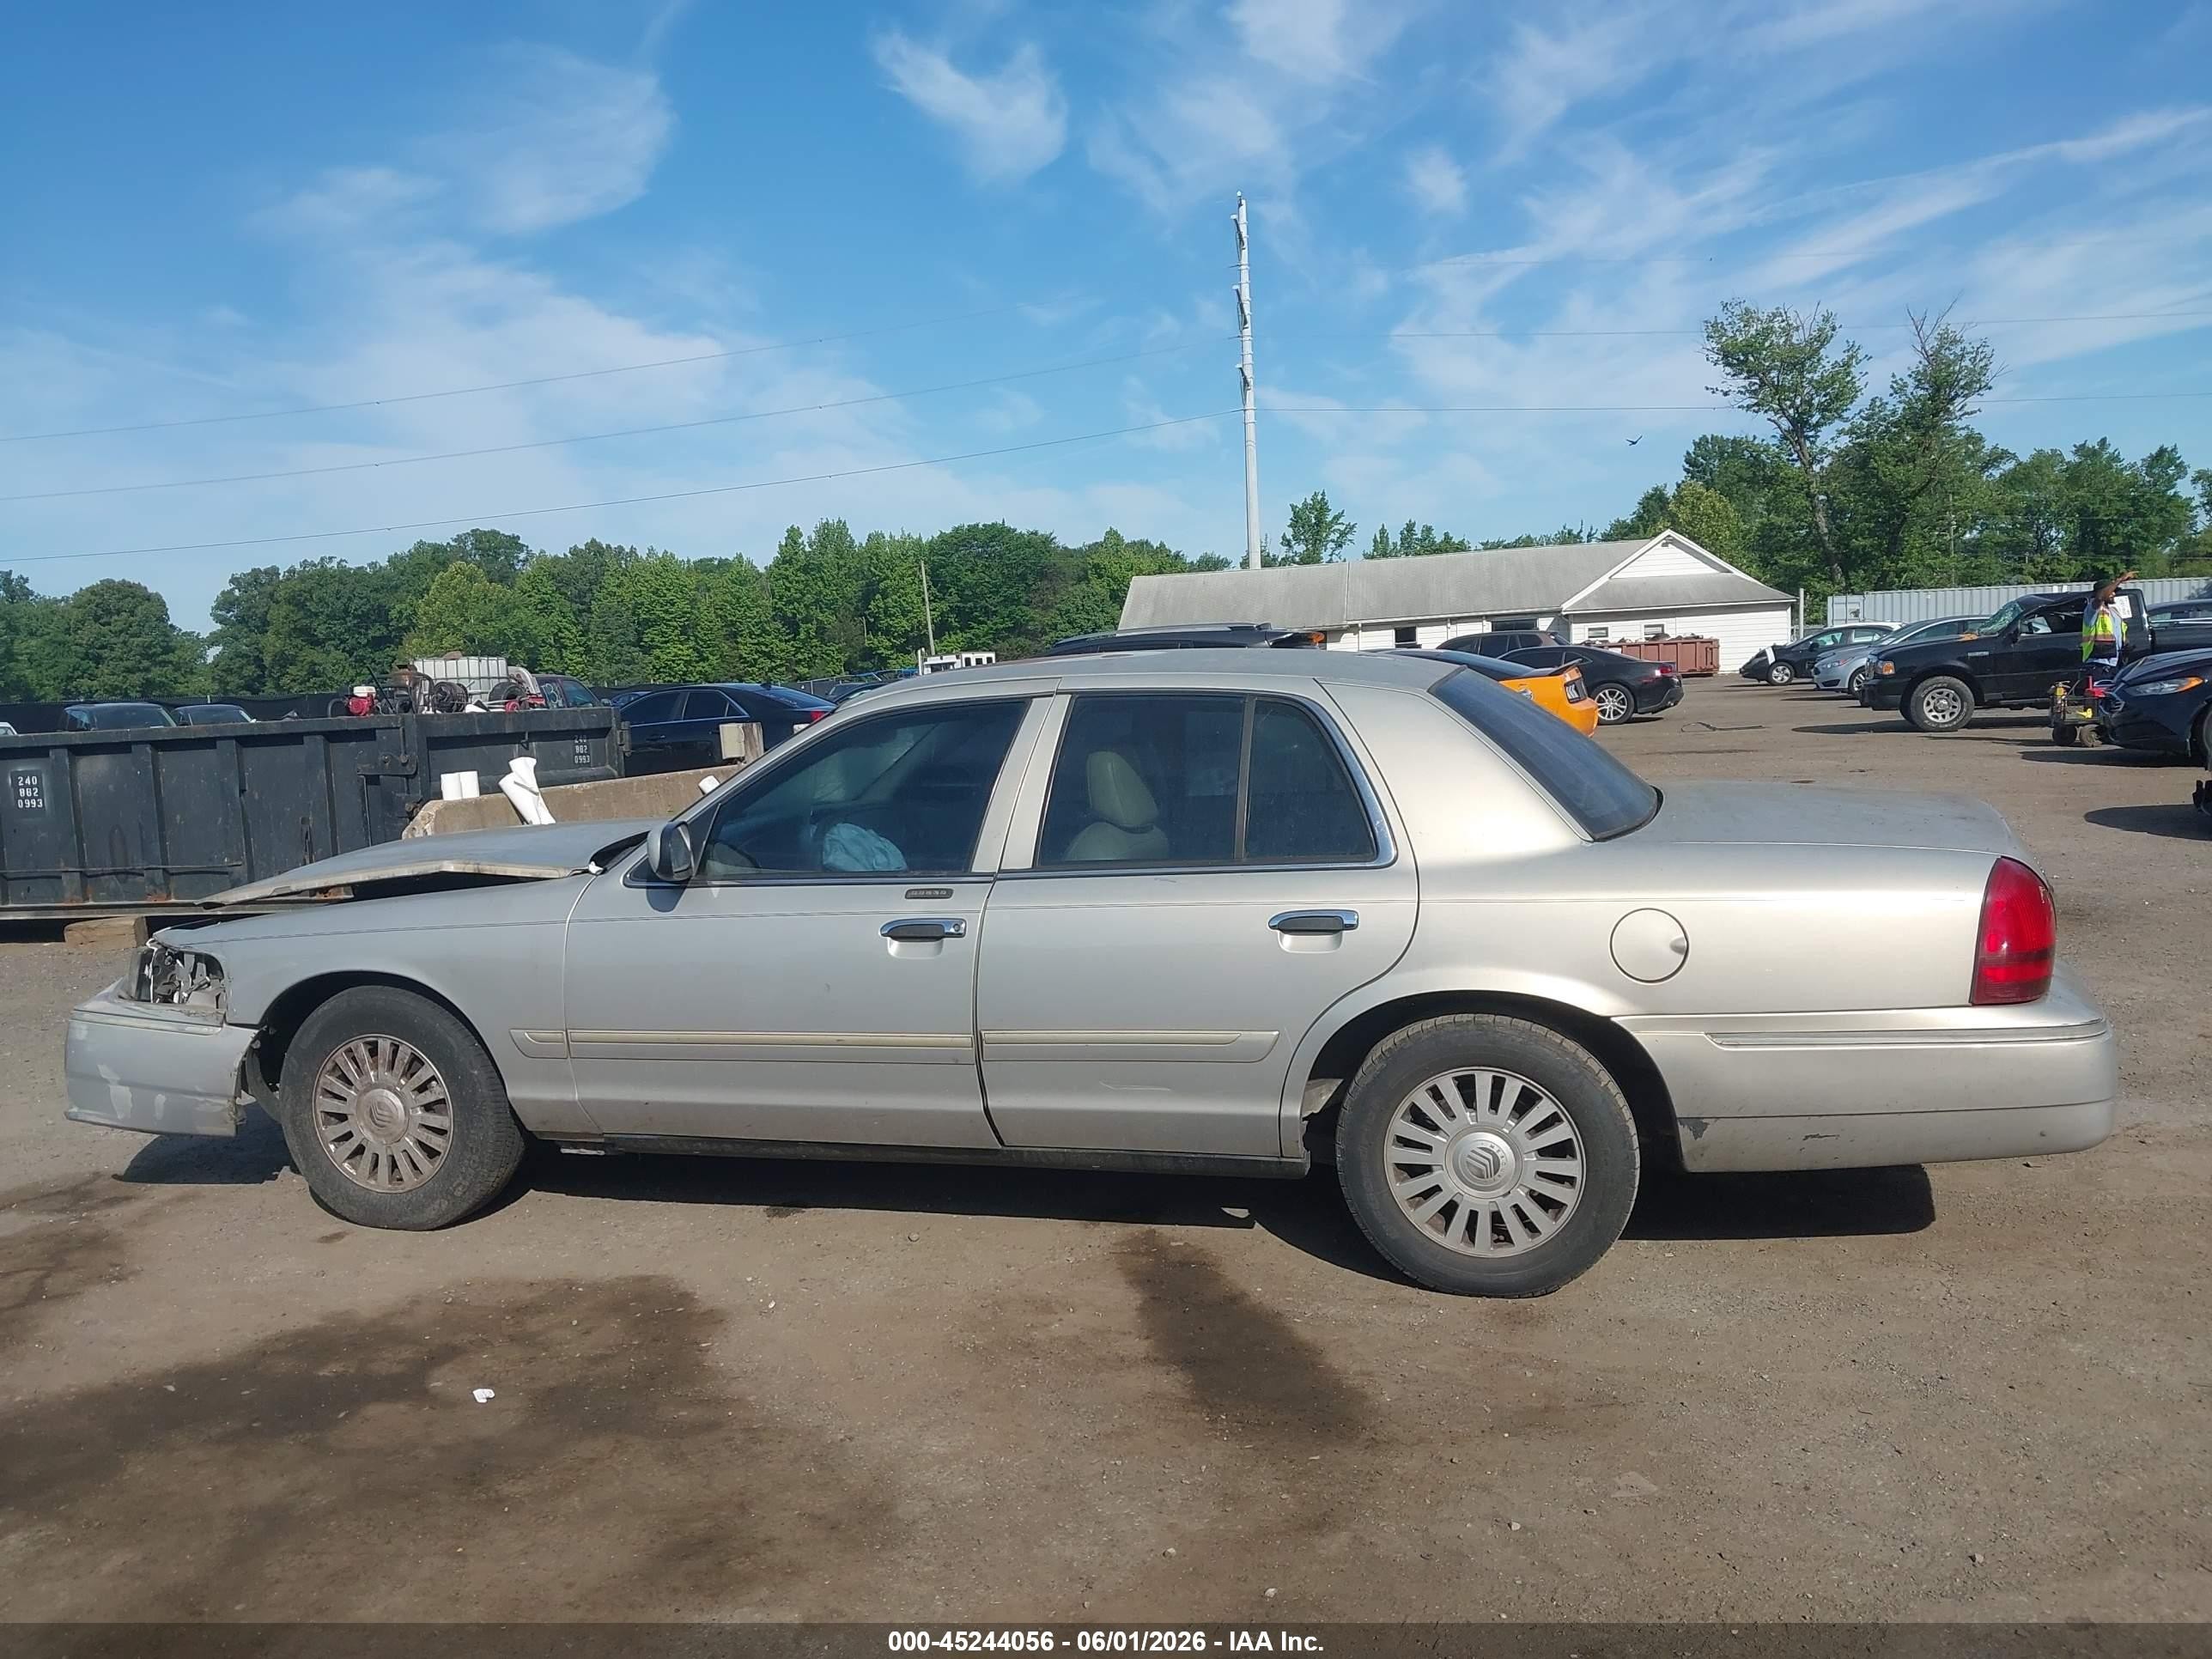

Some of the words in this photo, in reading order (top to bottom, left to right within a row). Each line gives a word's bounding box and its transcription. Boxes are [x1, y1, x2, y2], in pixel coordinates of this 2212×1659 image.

[17, 775, 38, 787] 240
[19, 787, 39, 798] 882
[17, 799, 43, 809] 0993
